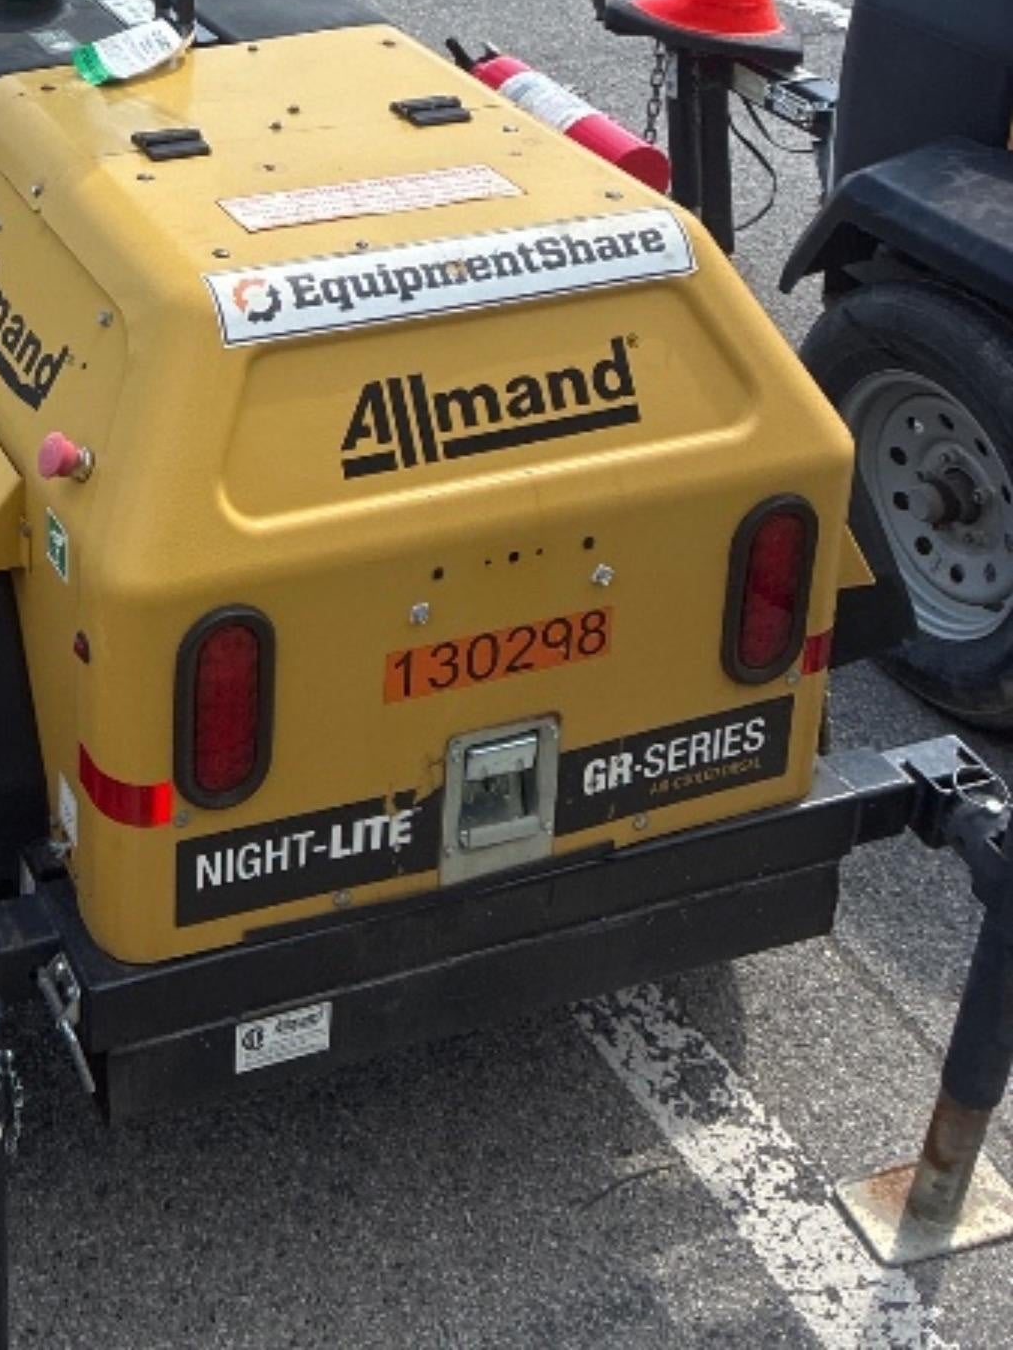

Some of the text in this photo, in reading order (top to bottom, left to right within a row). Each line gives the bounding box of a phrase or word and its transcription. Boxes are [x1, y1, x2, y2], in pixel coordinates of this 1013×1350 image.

[286, 226, 666, 312] EquipmentShare
[340, 334, 638, 469] Allmand
[393, 608, 608, 697] 130298
[196, 808, 414, 891] NIGHT-LITE
